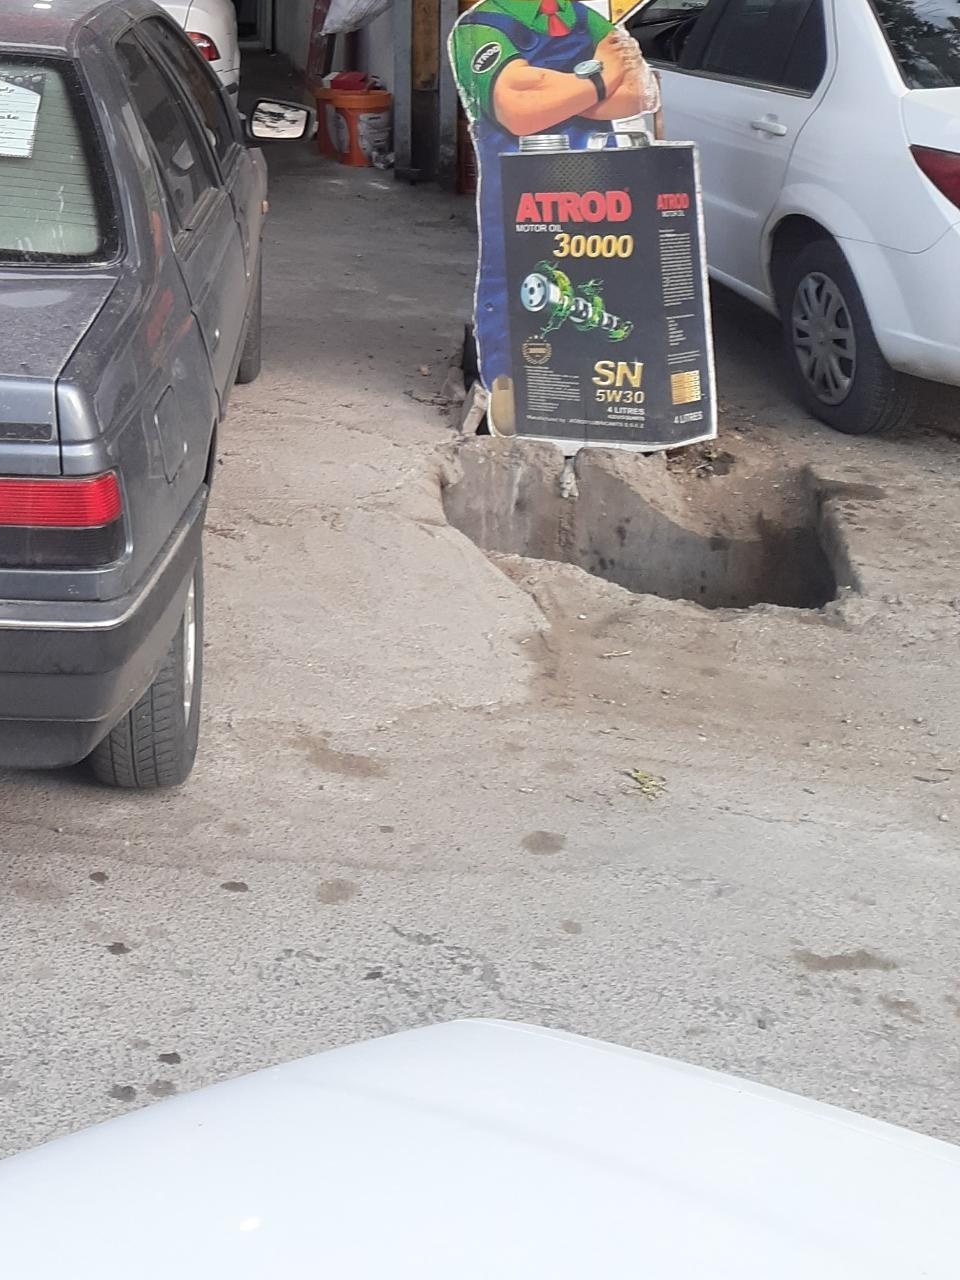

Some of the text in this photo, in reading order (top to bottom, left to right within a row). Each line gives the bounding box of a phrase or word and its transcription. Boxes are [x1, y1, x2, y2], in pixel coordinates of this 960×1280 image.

[474, 45, 500, 70] ATROD
[515, 190, 632, 223] ATROD
[515, 224, 563, 232] MOTOR OIL
[553, 233, 634, 258] 30000
[591, 360, 644, 388] SN
[595, 390, 645, 404] 5W30
[614, 406, 645, 415] LITRES
